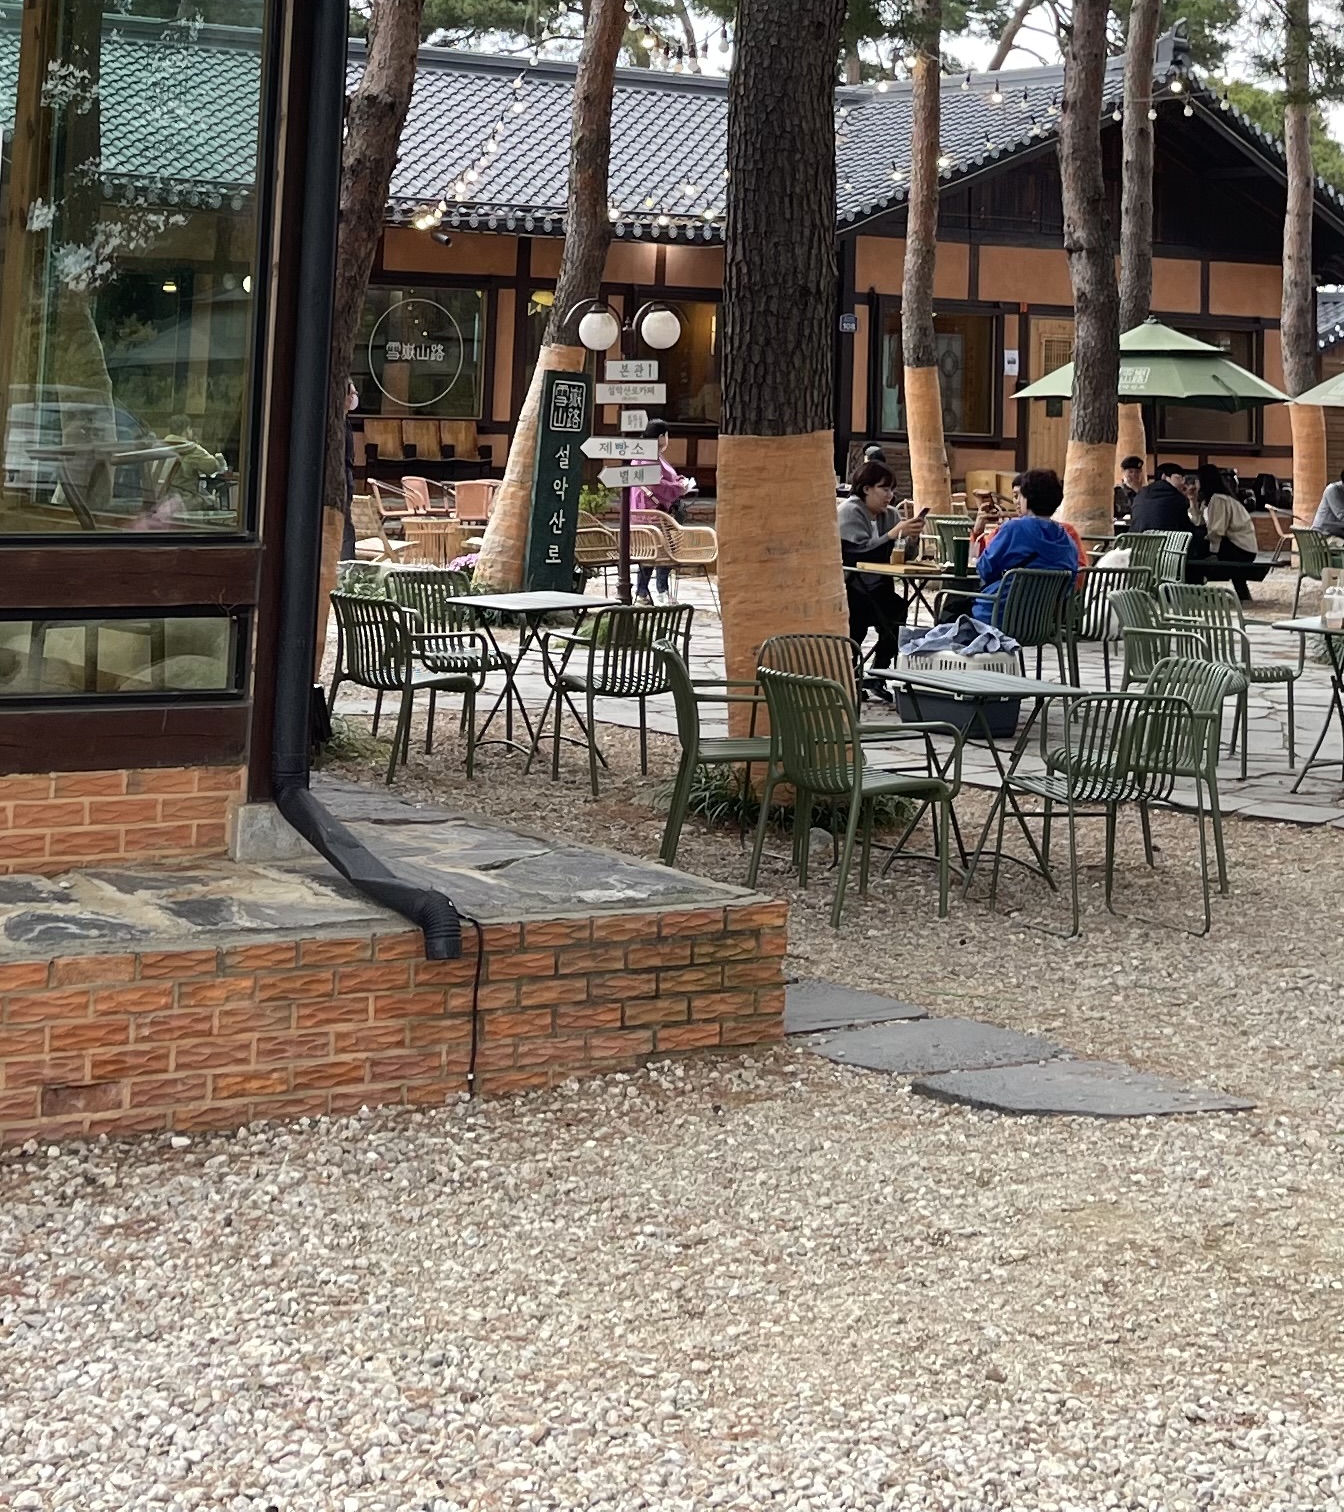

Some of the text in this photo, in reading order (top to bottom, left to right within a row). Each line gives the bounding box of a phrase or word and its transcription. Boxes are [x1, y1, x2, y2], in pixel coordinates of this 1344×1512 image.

[599, 441, 645, 456] 제빵소
[619, 469, 645, 484] 별채
[545, 443, 571, 564] 설악산로
